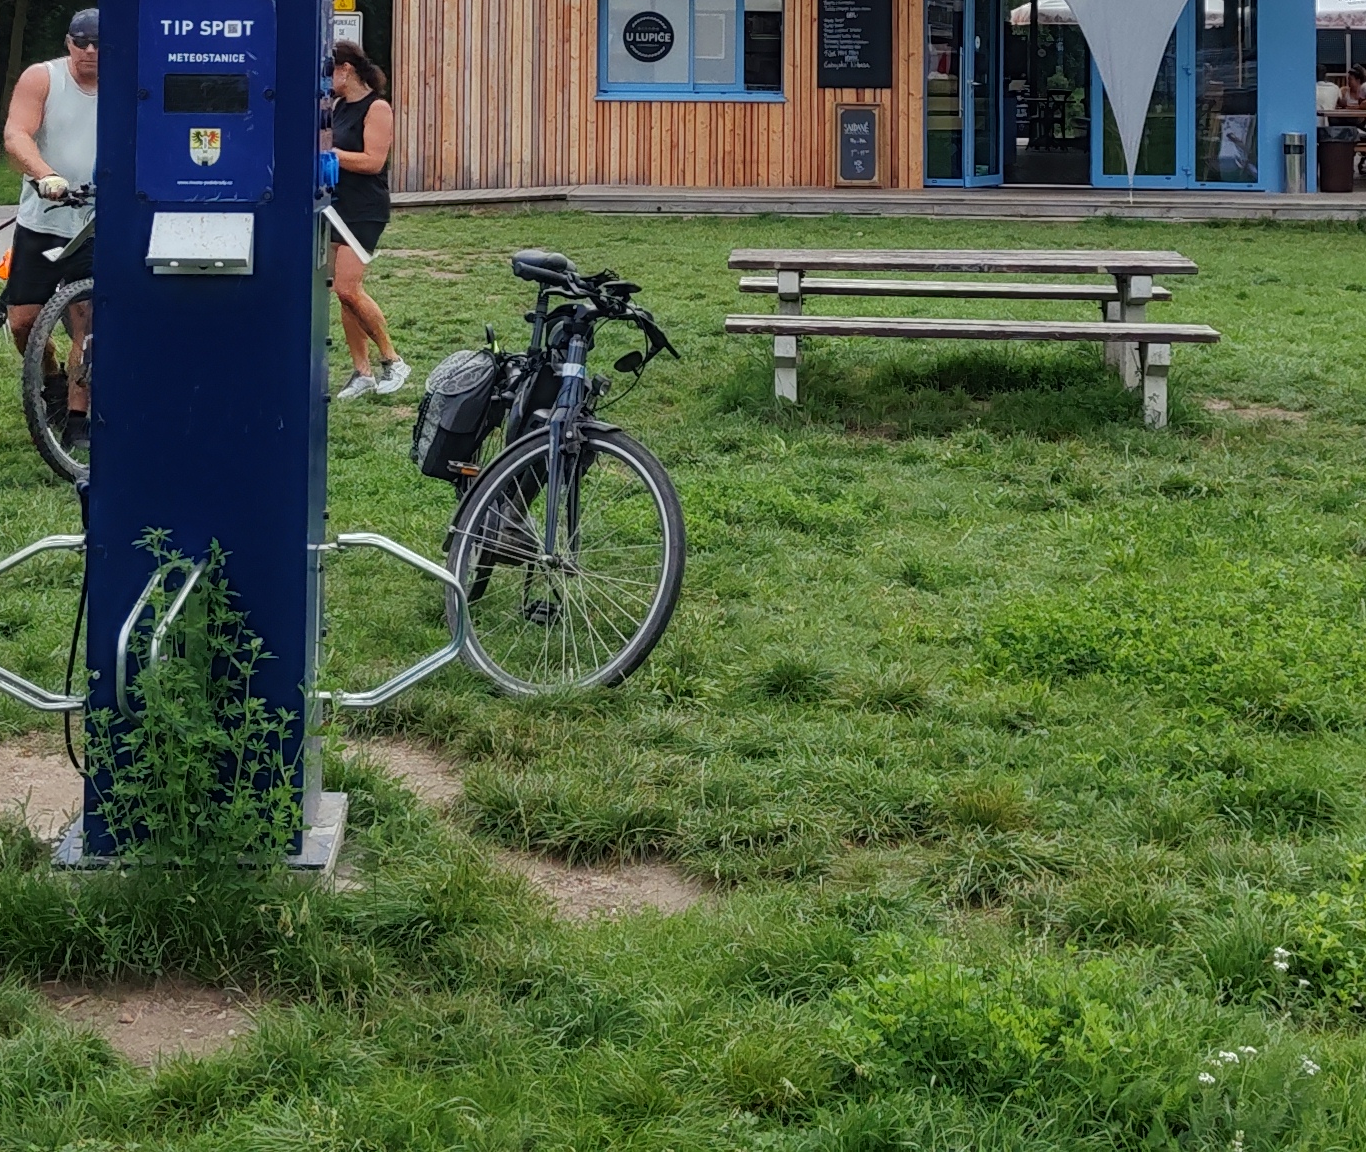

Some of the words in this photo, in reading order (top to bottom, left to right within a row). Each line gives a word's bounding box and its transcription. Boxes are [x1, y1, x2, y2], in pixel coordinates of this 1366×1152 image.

[160, 20, 194, 36] TIP
[200, 20, 254, 38] SPOT
[626, 32, 634, 42] U
[168, 53, 246, 63] METEOSTANICE
